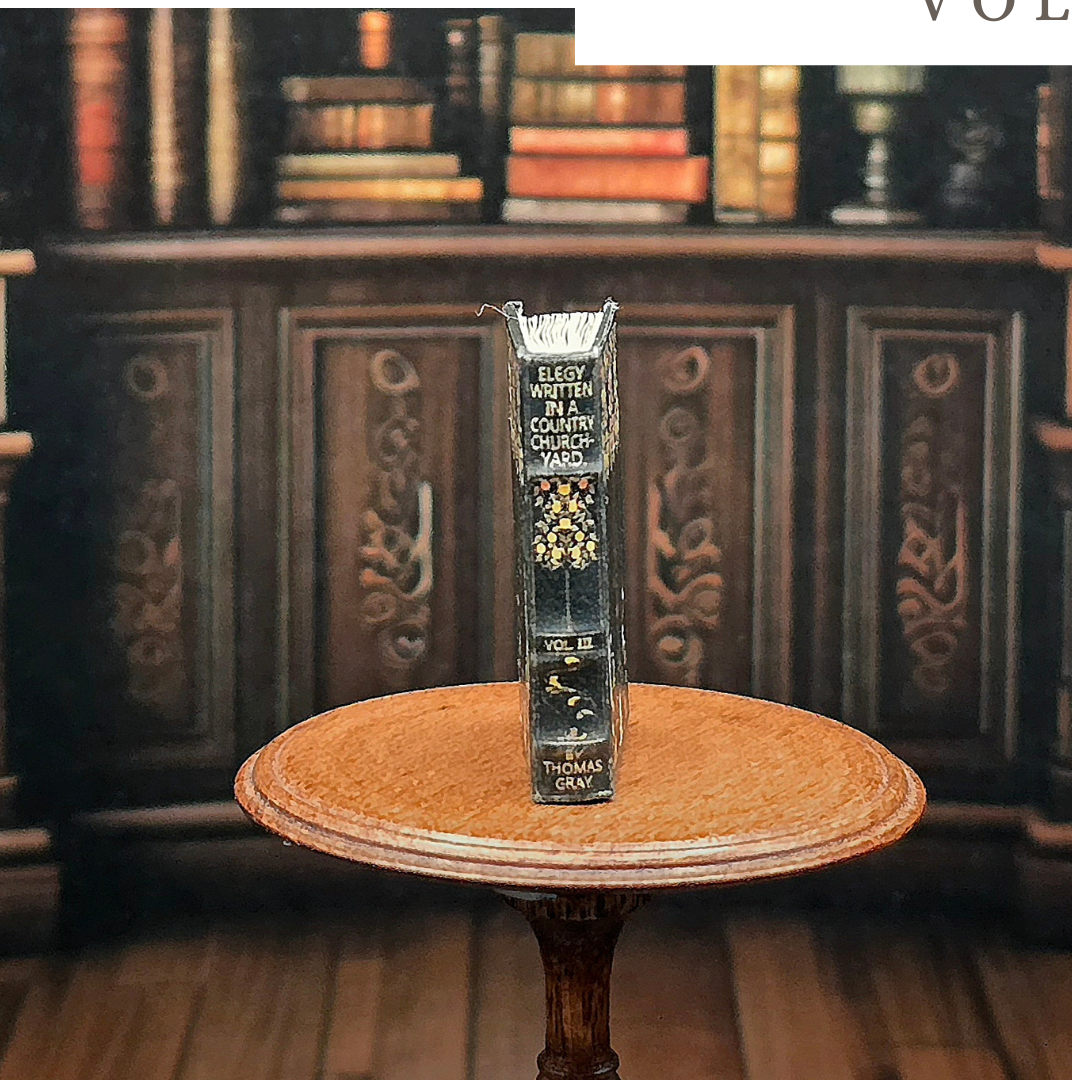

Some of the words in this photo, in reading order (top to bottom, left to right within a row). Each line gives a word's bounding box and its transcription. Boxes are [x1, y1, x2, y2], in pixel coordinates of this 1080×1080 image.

[538, 364, 586, 382] ELEGY
[529, 381, 594, 399] WRITTEN
[545, 400, 564, 417] IN
[567, 400, 580, 416] A
[530, 414, 595, 434] COUNTRY
[530, 431, 595, 451] CHURCH-
[544, 638, 574, 651] VOL
[577, 637, 594, 651] III
[542, 758, 603, 776] THOMAS
[554, 775, 594, 792] GRAY
